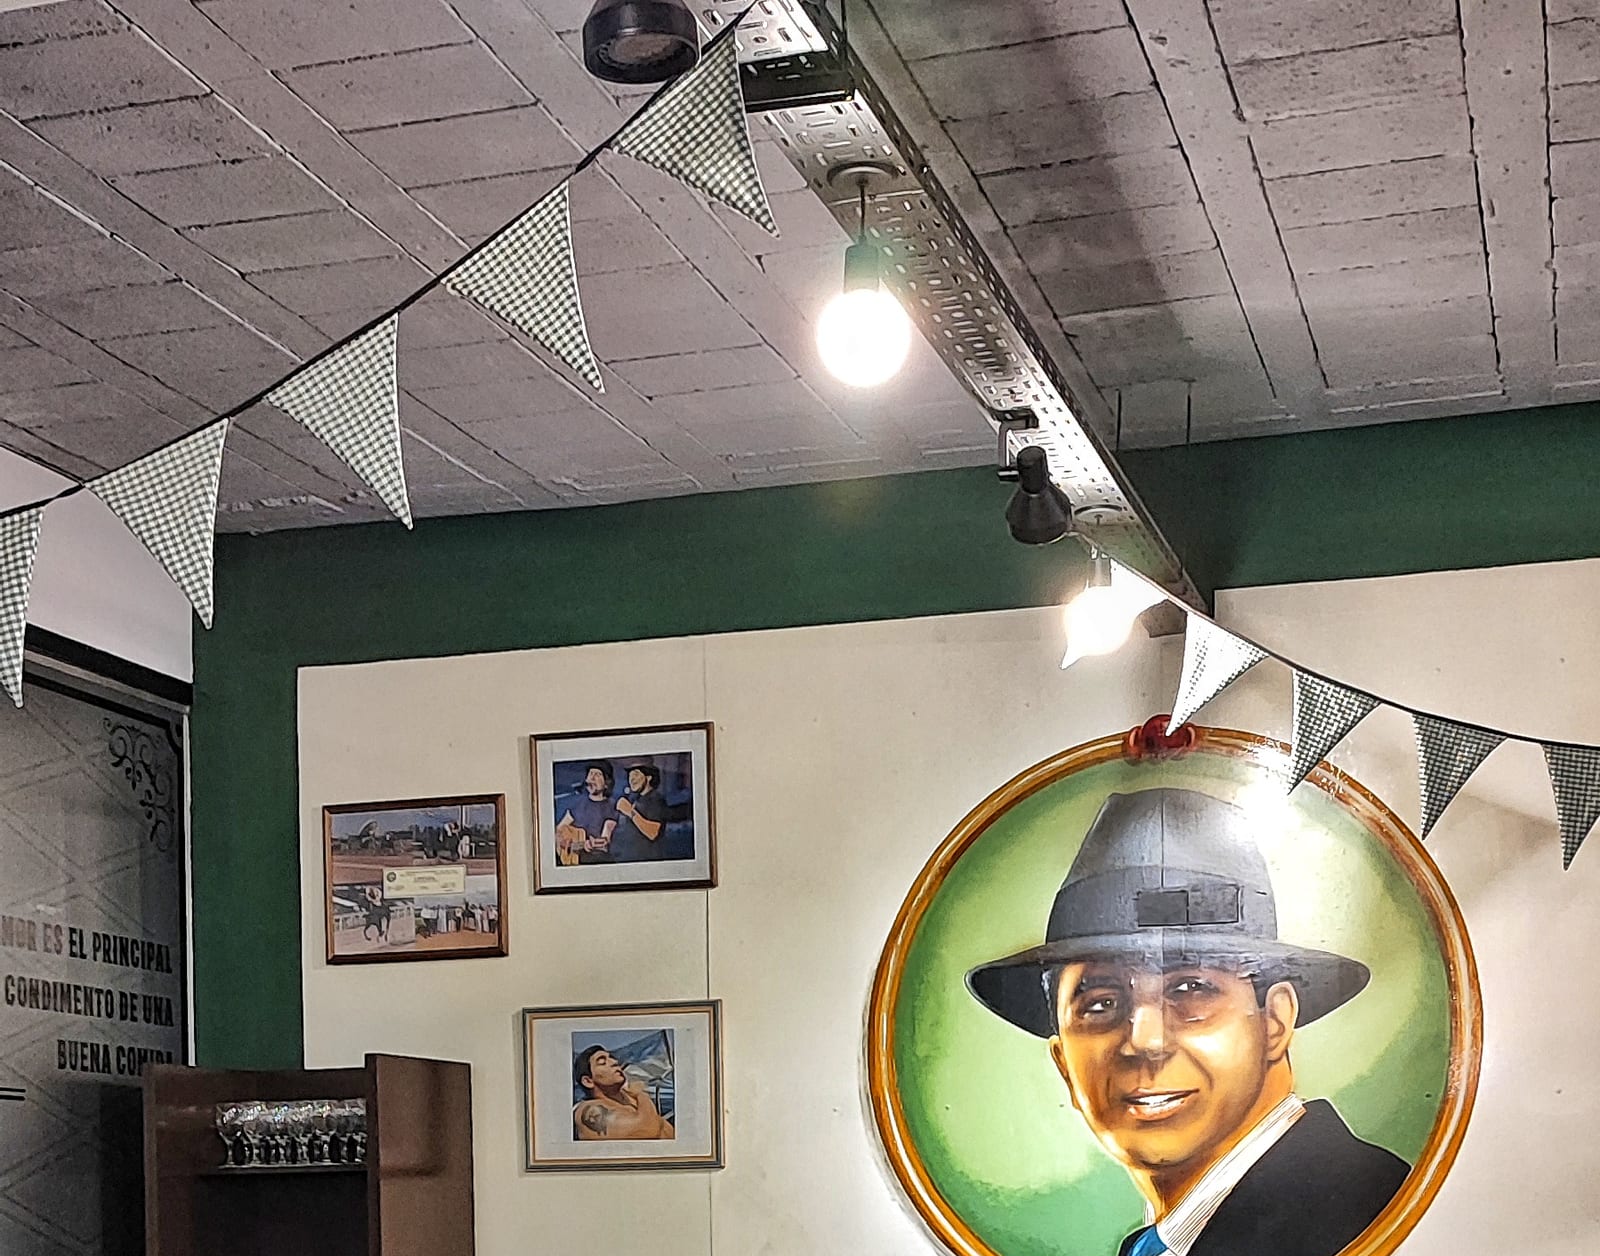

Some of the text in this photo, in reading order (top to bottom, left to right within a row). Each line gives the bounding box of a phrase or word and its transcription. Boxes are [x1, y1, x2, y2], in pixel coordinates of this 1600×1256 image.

[42, 921, 63, 955] ES
[68, 926, 87, 959] EL
[92, 931, 172, 974] PRINCIPAL
[4, 974, 174, 1027] CONDIMENTO DE UNA
[57, 1039, 112, 1075] BUENA
